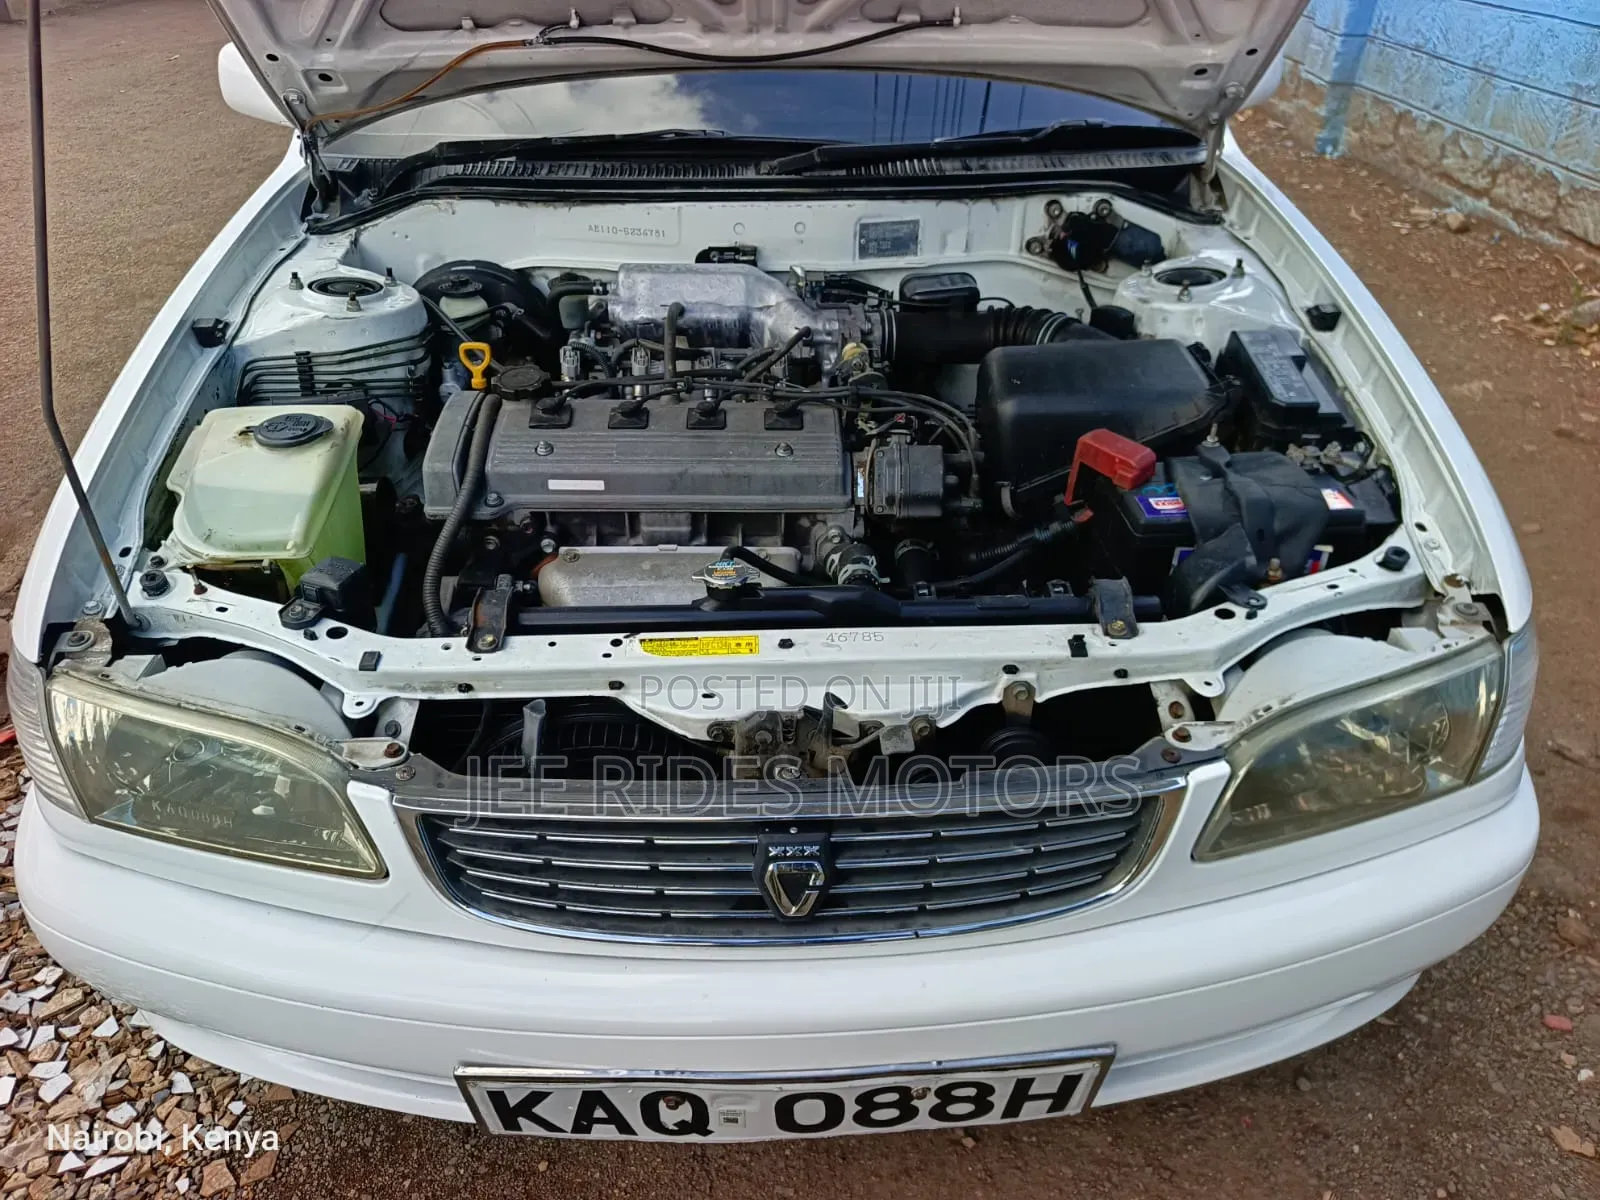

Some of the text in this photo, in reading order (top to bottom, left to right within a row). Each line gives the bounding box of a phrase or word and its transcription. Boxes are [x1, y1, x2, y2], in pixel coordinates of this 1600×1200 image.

[825, 631, 885, 643] 46785
[486, 1073, 1084, 1137] KAQ 088H
